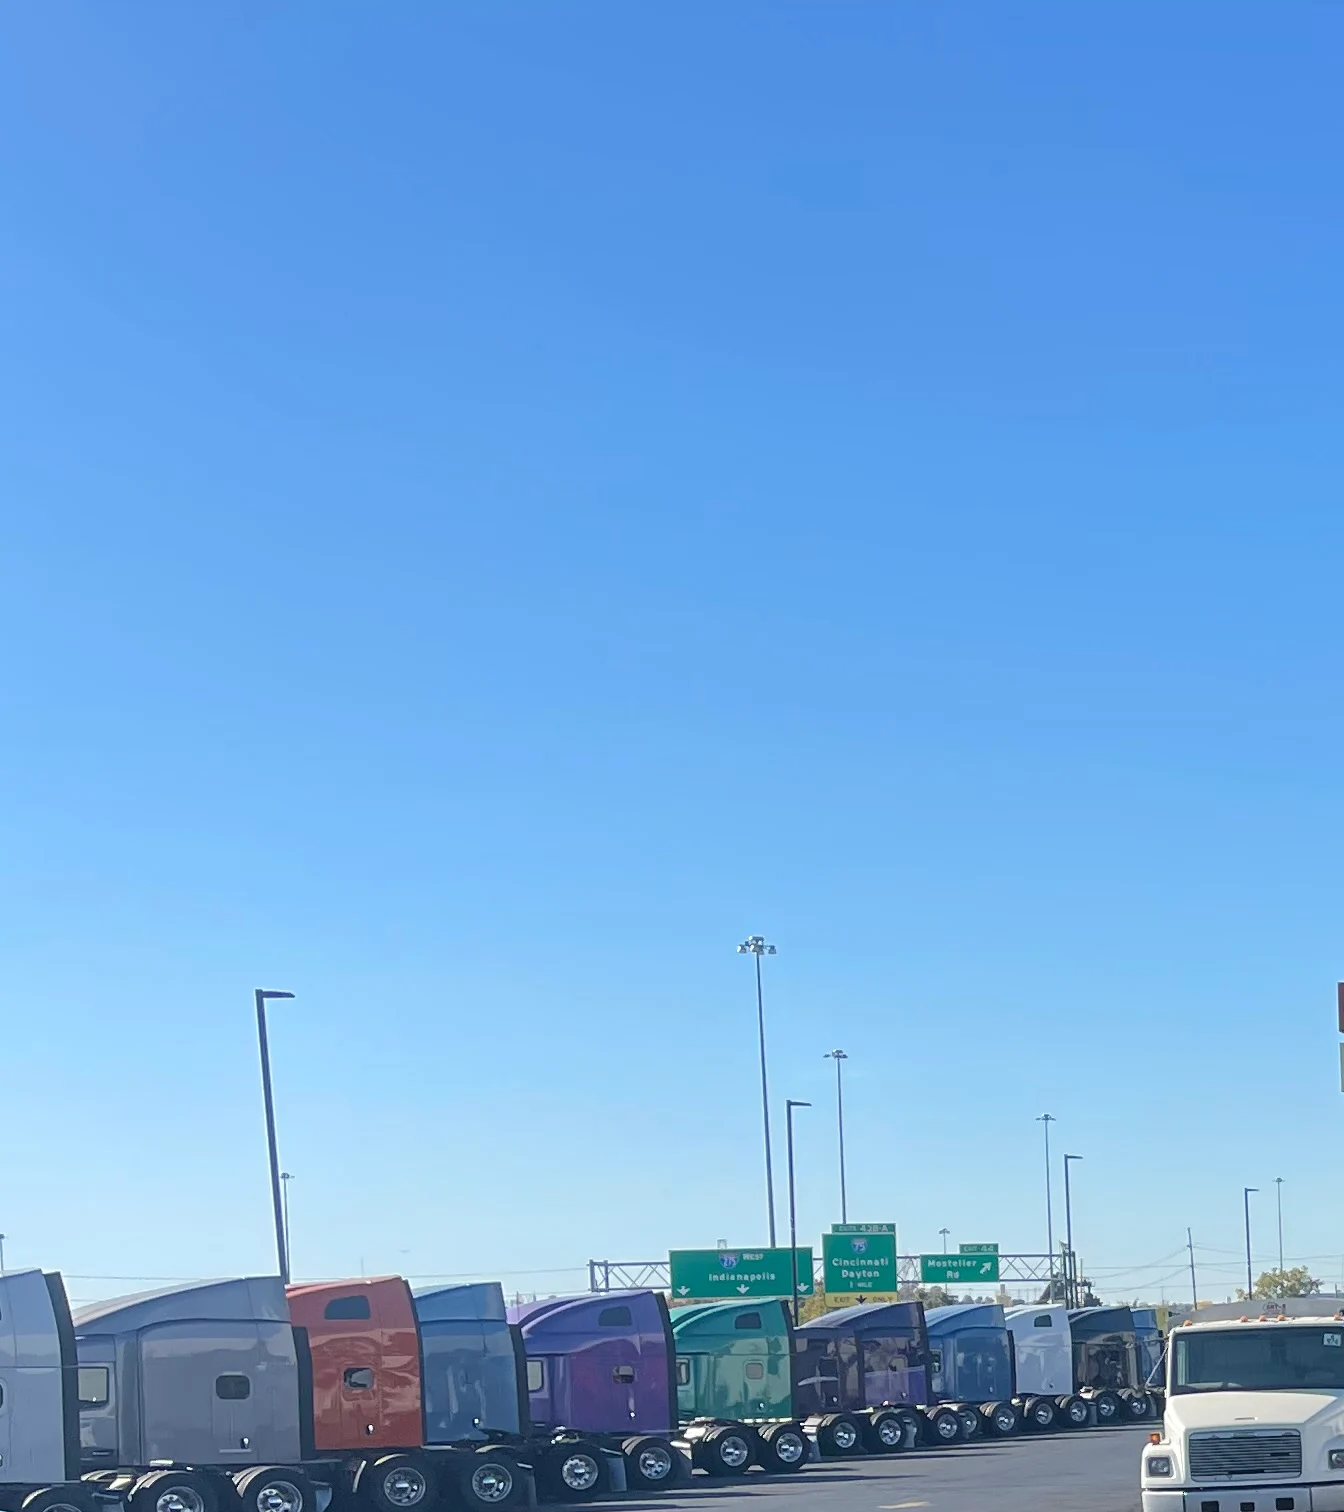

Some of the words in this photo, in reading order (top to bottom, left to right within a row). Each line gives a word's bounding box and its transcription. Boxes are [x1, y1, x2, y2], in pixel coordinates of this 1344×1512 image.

[980, 1244, 994, 1252] 44
[831, 1257, 889, 1267] Cincinnati
[927, 1259, 977, 1267] Mosteller
[708, 1271, 776, 1282] Indianapolis
[841, 1269, 880, 1279] Dayton
[946, 1270, 960, 1279] Rd
